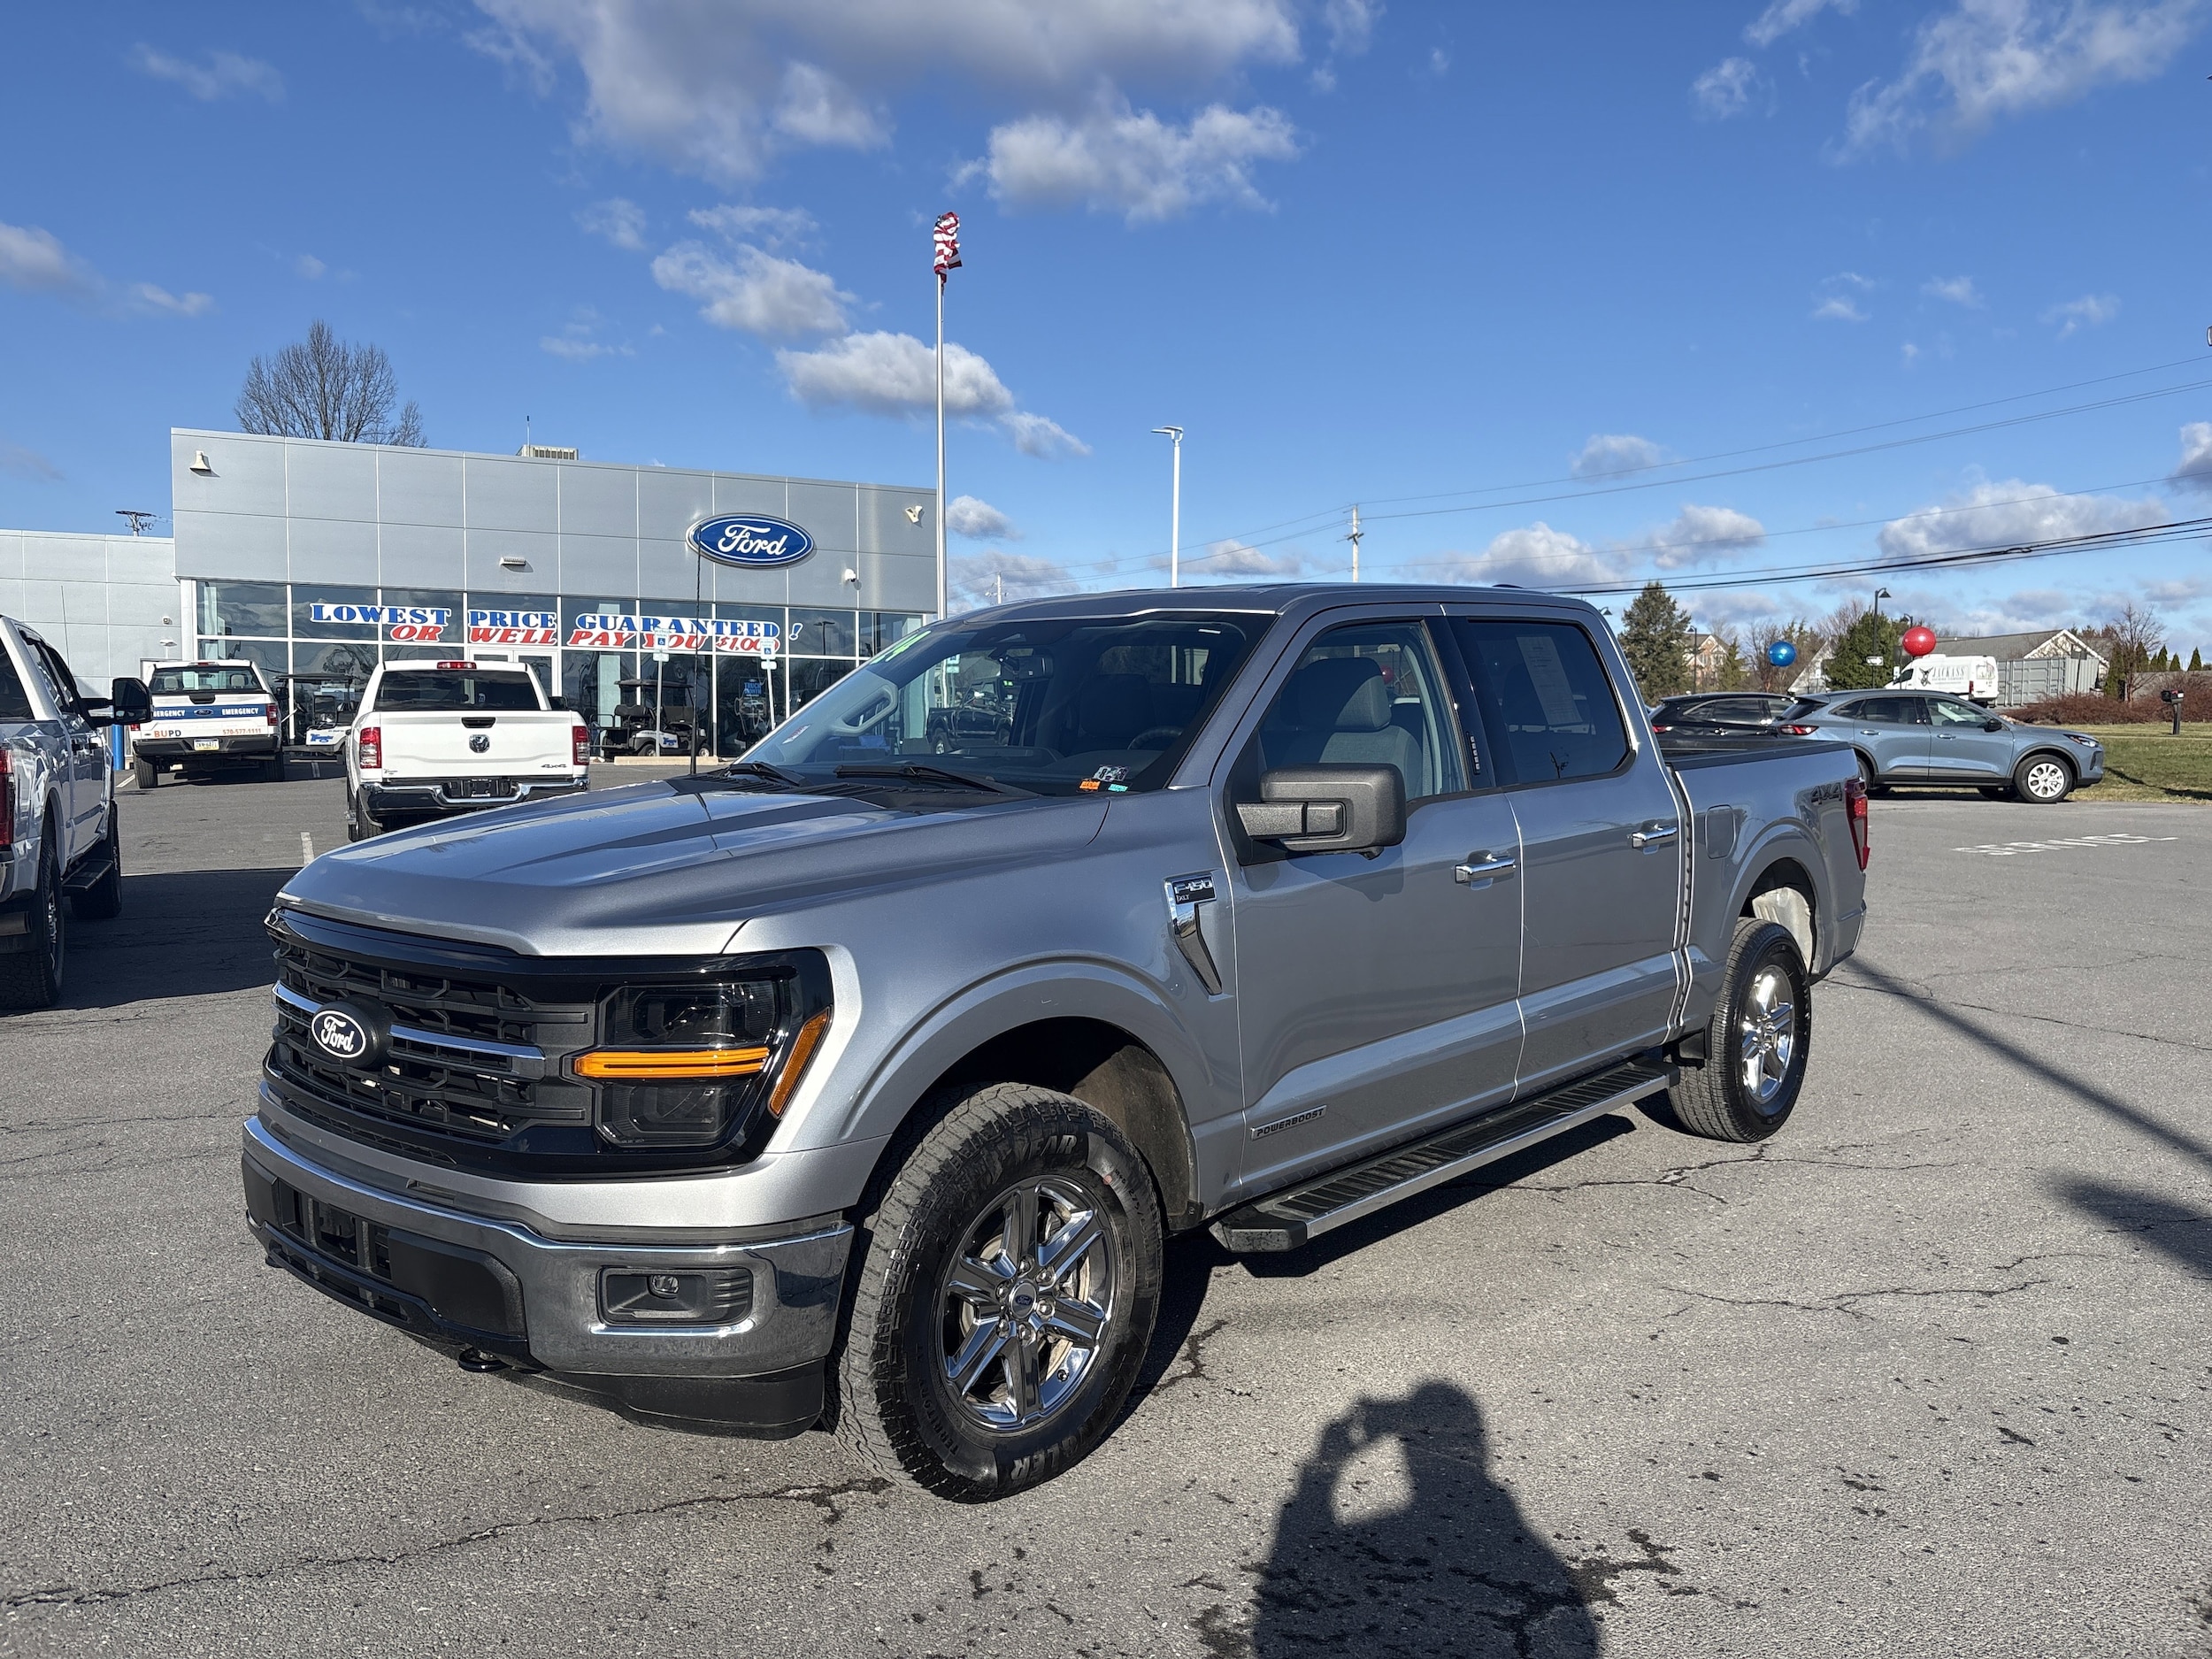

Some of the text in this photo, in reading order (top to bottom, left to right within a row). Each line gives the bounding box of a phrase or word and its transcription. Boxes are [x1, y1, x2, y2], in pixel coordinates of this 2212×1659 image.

[718, 524, 788, 556] Ford
[311, 604, 450, 626] LOWEST
[467, 611, 557, 628] PRICE
[575, 614, 780, 638] GUARANTEED
[391, 625, 444, 641] OR
[470, 627, 557, 644] WE'LL
[568, 630, 635, 647] PAY
[717, 636, 780, 651] $1,00
[320, 1015, 355, 1052] Ford
[1256, 1108, 1325, 1137] POWERBOOST
